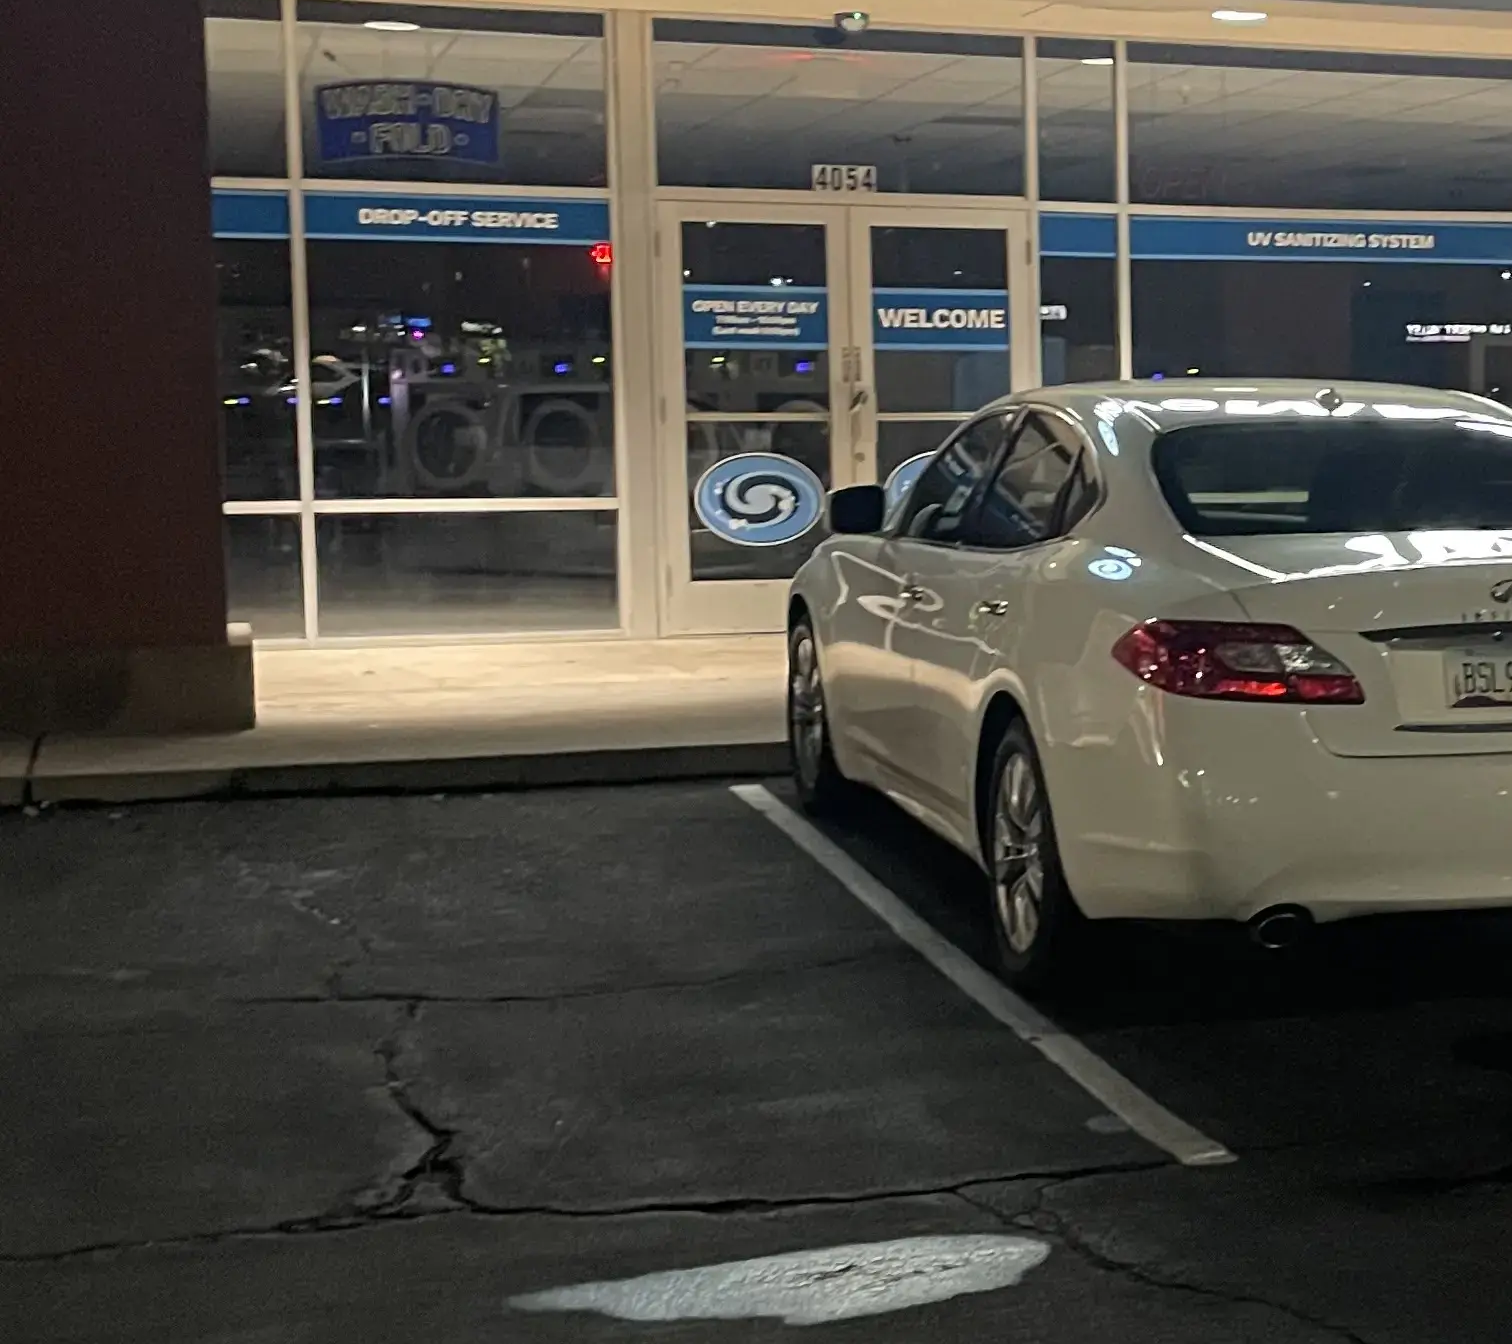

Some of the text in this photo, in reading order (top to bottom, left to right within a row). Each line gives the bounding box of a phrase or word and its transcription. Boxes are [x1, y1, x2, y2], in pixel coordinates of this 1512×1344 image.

[814, 166, 876, 191] 4054
[358, 208, 560, 229] DROP-OFF SERVICE
[1247, 232, 1435, 249] UV SANITIZING SYSTEM
[877, 308, 1006, 329] WELCOME
